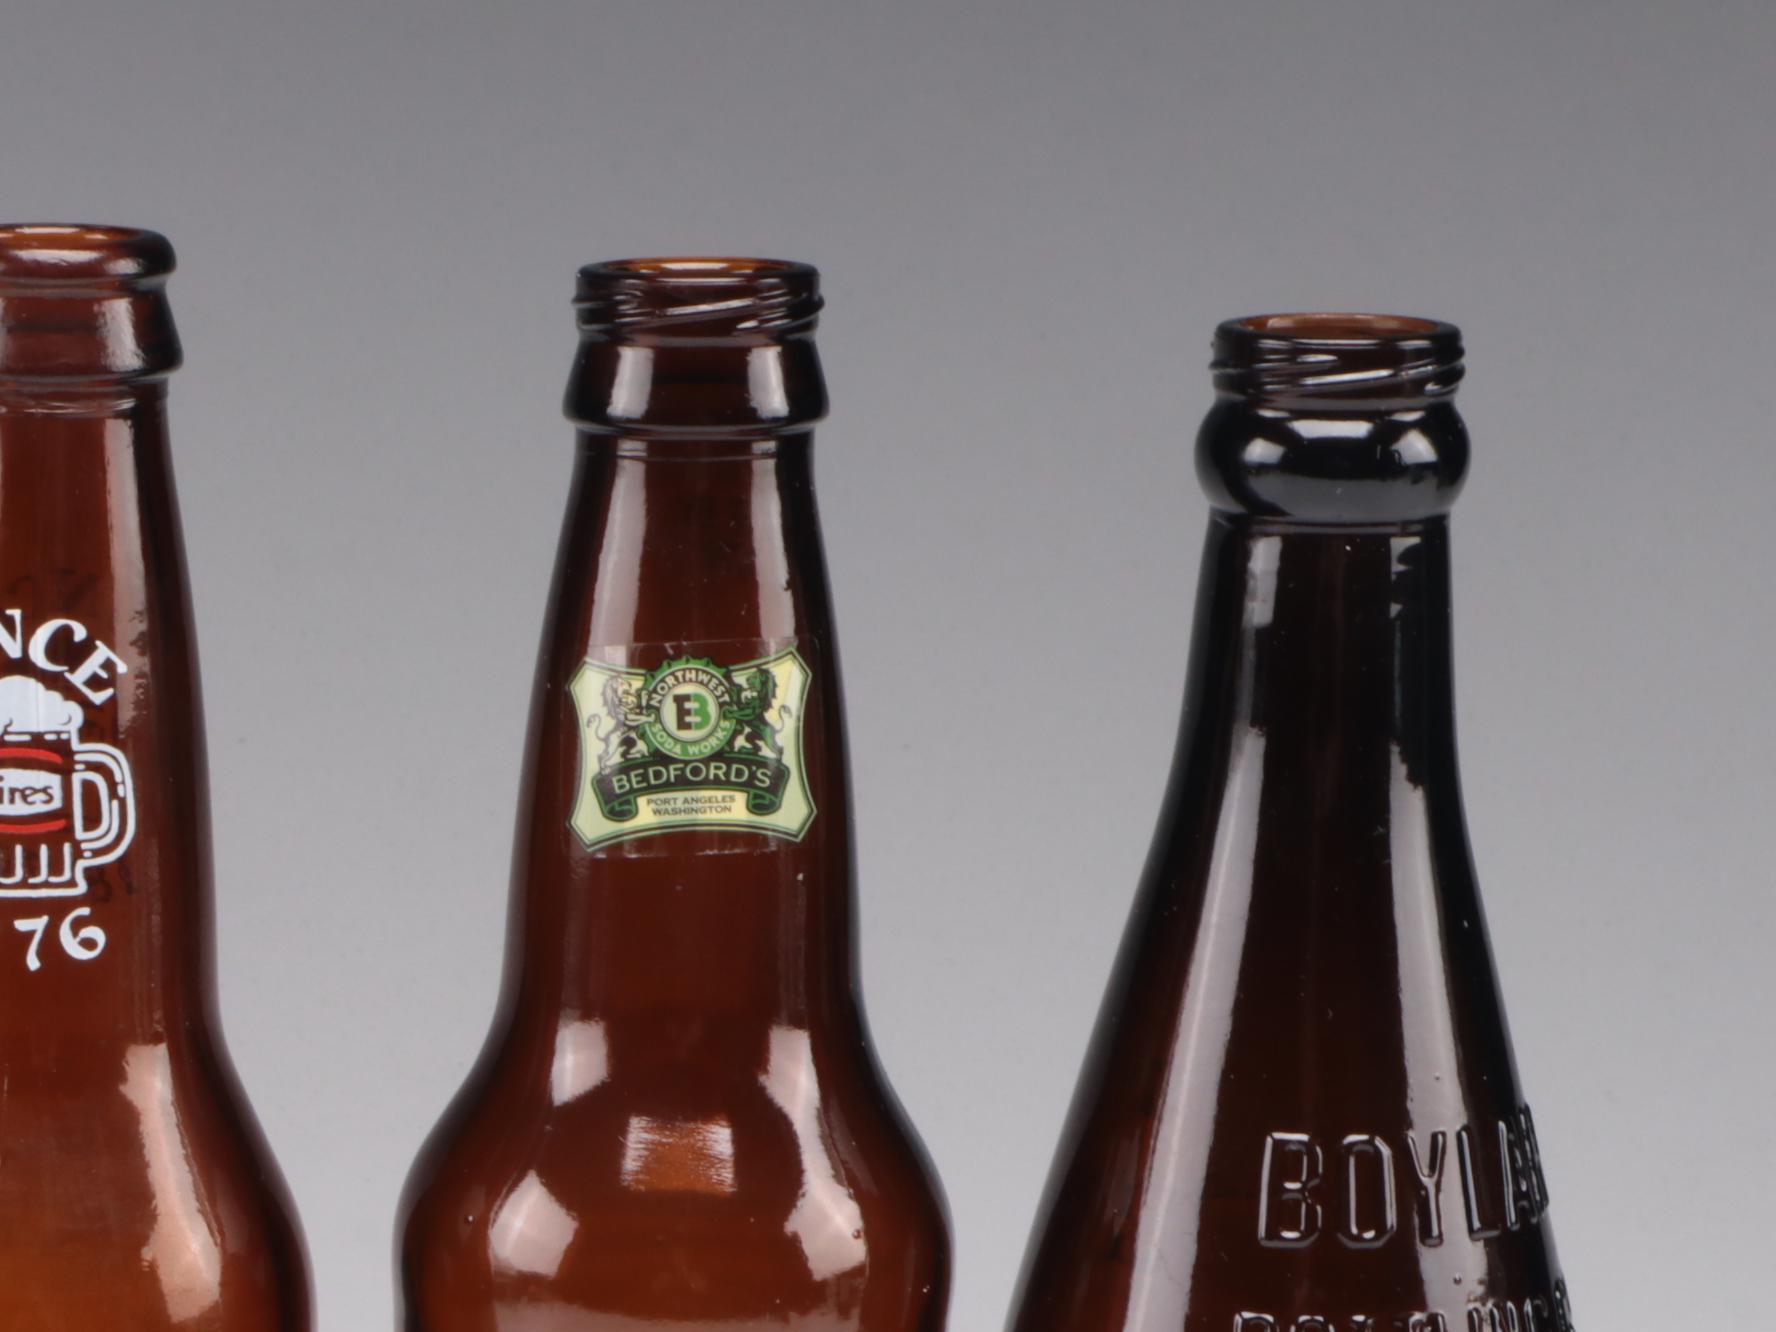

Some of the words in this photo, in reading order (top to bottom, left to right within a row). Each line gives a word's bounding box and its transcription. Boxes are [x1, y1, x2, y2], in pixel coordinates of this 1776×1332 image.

[650, 667, 730, 707] NORTHWEST
[651, 724, 681, 754] SODA
[687, 720, 730, 754] WORKS
[612, 762, 772, 795] BEDFORD'S
[647, 797, 678, 805] PORT
[682, 795, 736, 805] ANGELES
[652, 805, 732, 816] WASHINGTON
